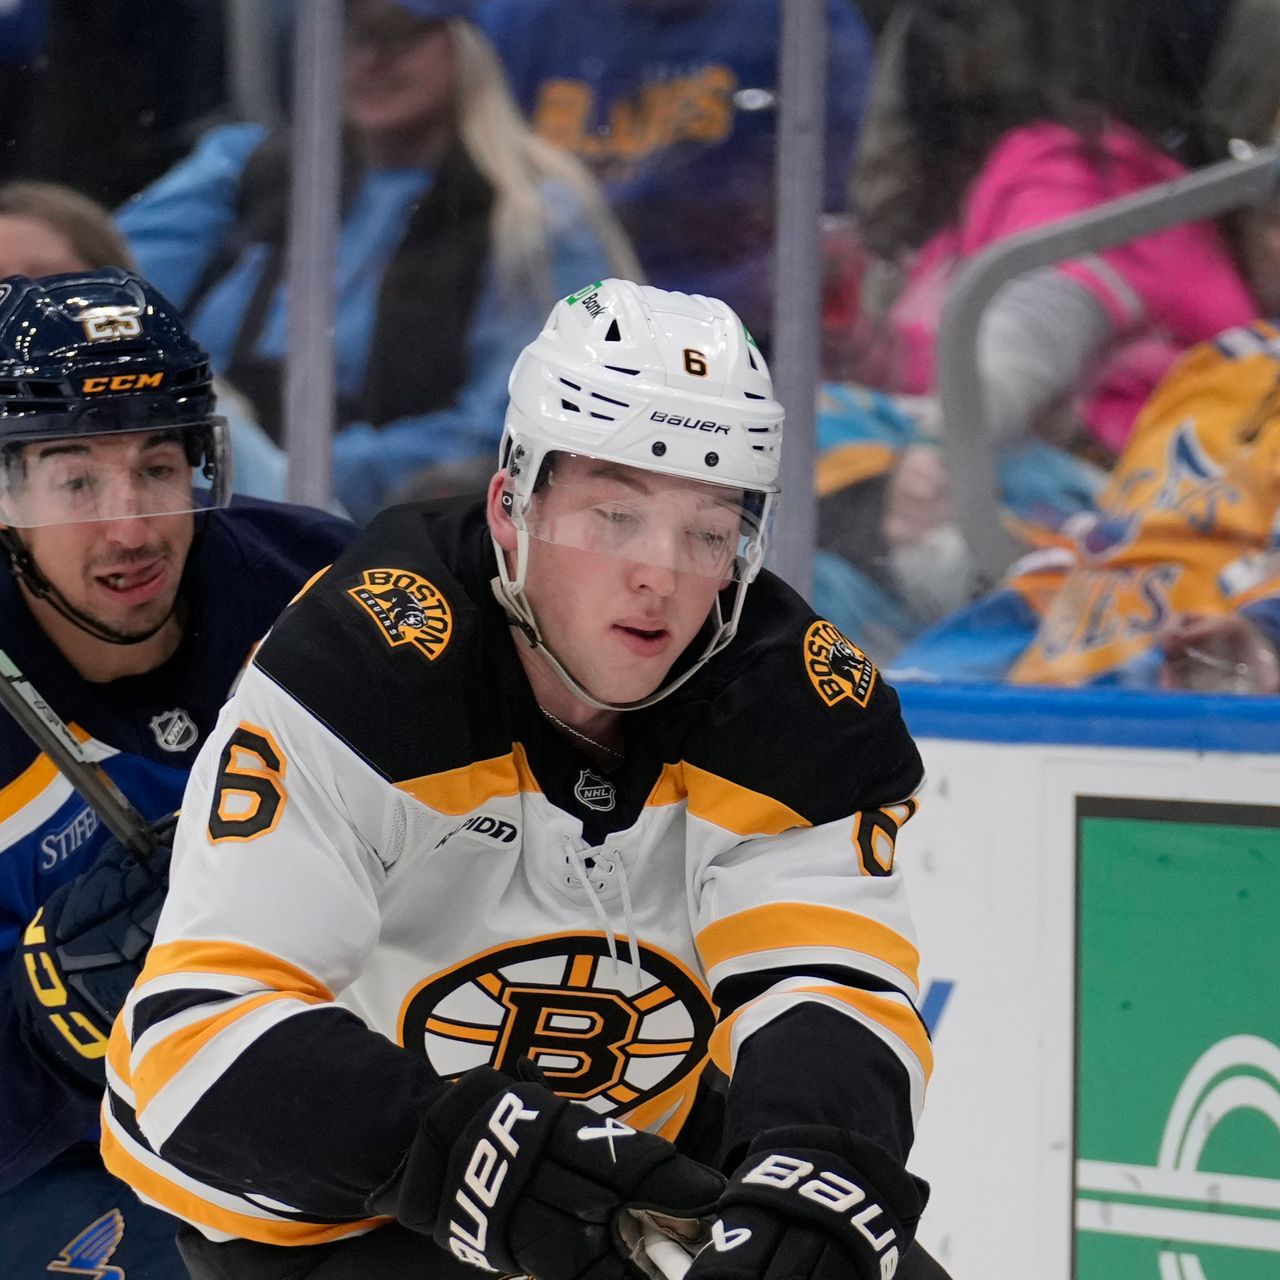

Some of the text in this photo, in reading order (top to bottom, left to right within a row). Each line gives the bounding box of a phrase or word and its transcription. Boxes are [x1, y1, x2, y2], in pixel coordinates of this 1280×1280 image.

[582, 292, 607, 319] Bank
[682, 348, 708, 378] 6
[82, 372, 164, 393] CCM
[360, 592, 398, 636] BRUINS
[367, 571, 449, 656] BOSTON
[207, 720, 288, 846] 6
[584, 787, 610, 799] NHL
[492, 985, 640, 1100] B
